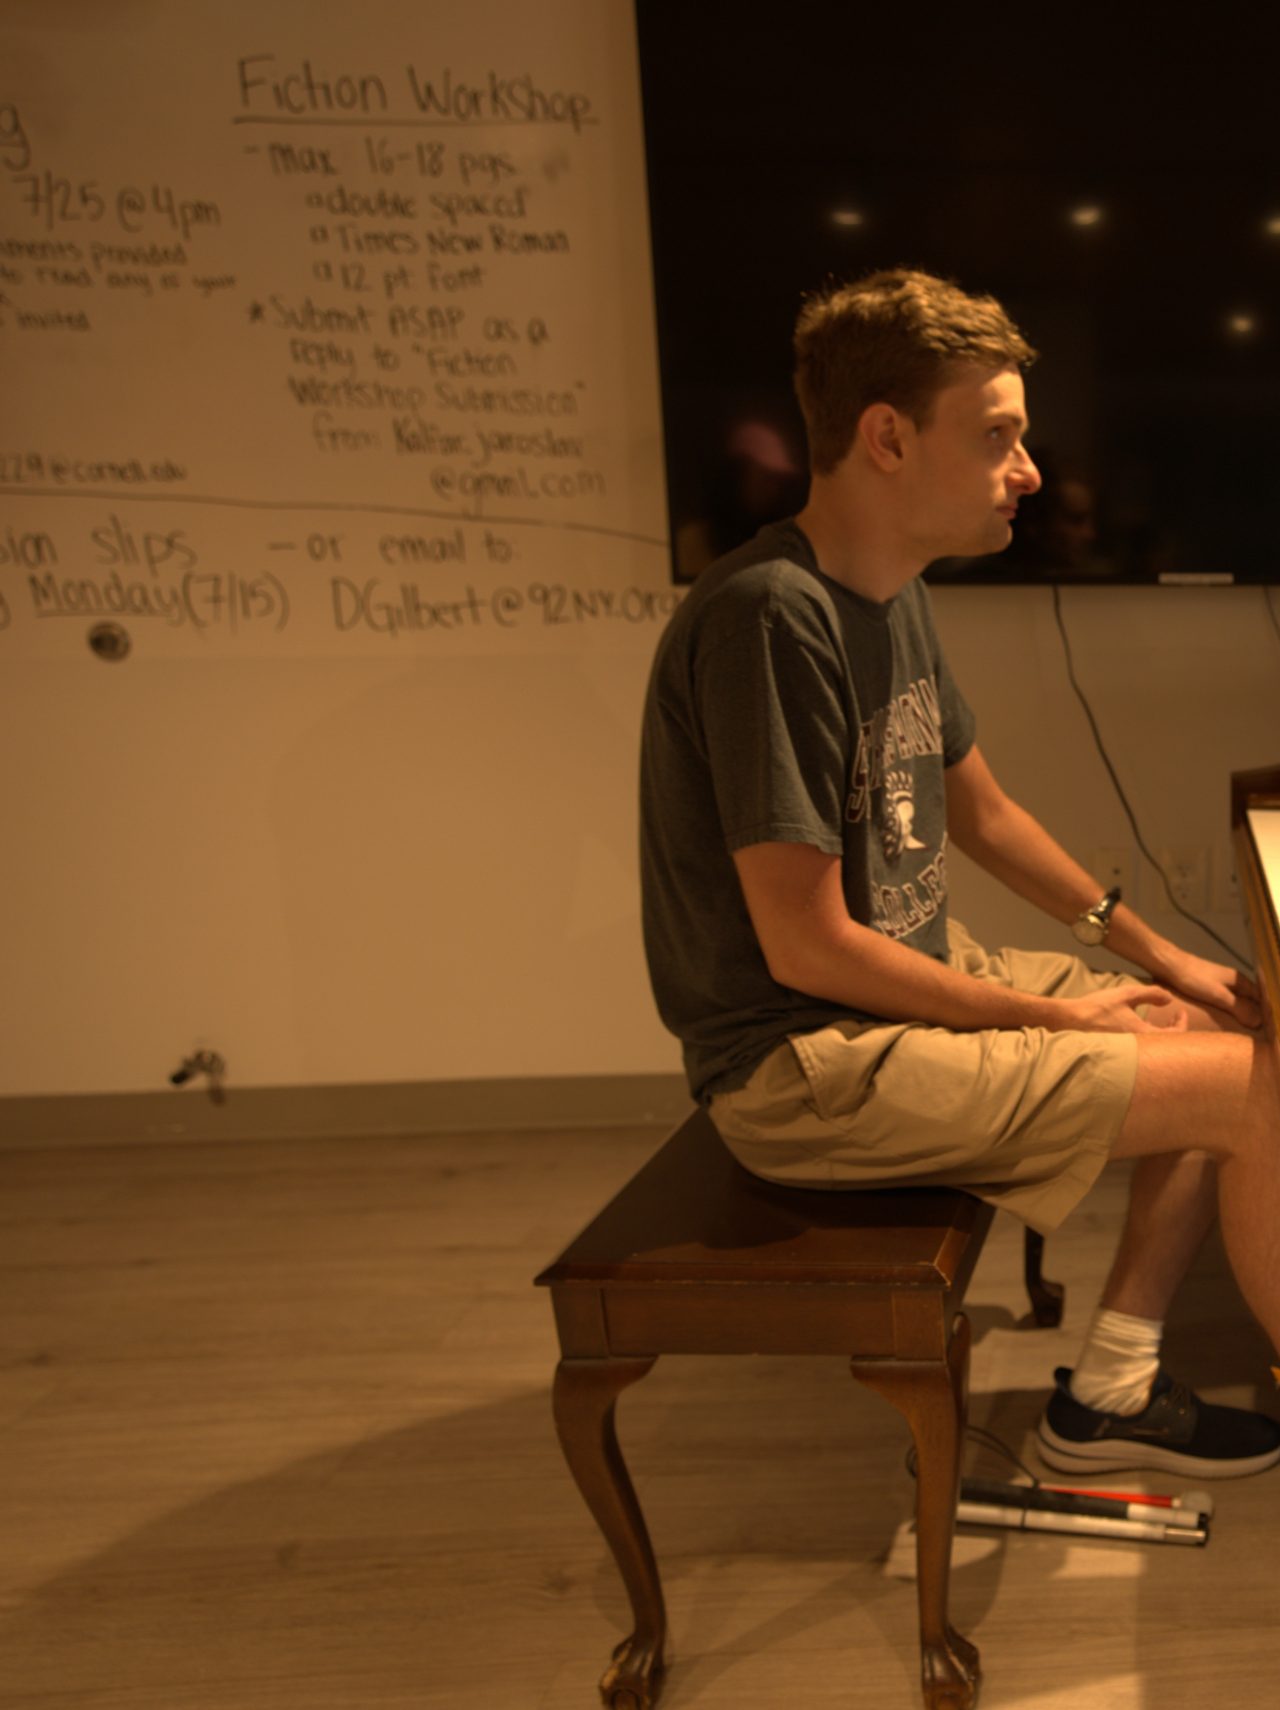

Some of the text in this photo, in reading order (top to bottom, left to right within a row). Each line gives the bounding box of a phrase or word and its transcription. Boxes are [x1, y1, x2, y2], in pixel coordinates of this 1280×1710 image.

[237, 52, 388, 114] Fiction
[335, 224, 420, 255] Times
[427, 228, 484, 255] New
[388, 304, 464, 340] ASAP
[482, 317, 521, 343] as
[90, 511, 199, 577] slips
[305, 529, 345, 565] or
[378, 528, 467, 566] email
[482, 529, 514, 565] to
